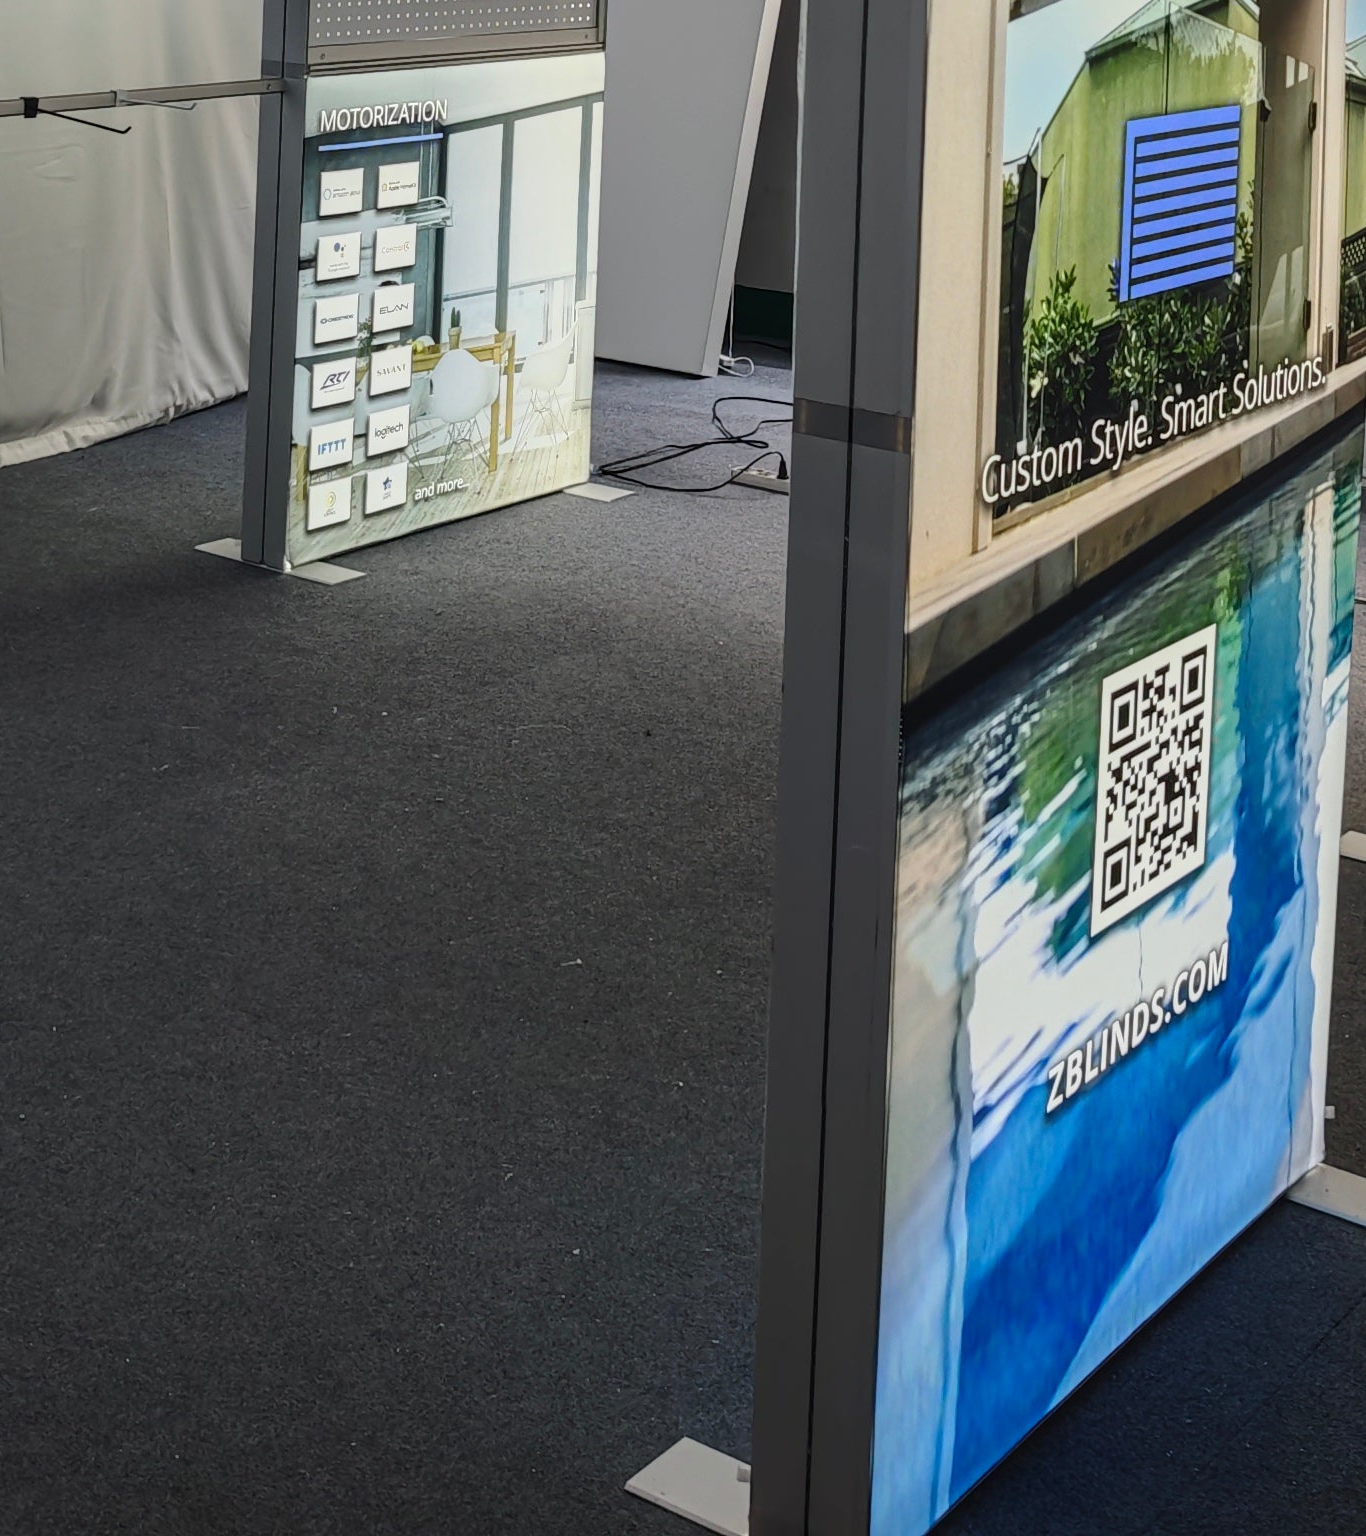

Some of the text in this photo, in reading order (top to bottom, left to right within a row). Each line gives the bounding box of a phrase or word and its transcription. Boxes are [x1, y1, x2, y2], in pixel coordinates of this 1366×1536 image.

[320, 99, 448, 132] MOTORIZATION
[379, 303, 409, 315] ELAN
[374, 422, 404, 439] logitech
[982, 356, 1327, 504] Custom Style. Smart Solutions.
[318, 439, 346, 455] IFTTT
[414, 484, 434, 501] and
[1046, 942, 1229, 1114] ZBLINDS.COM
